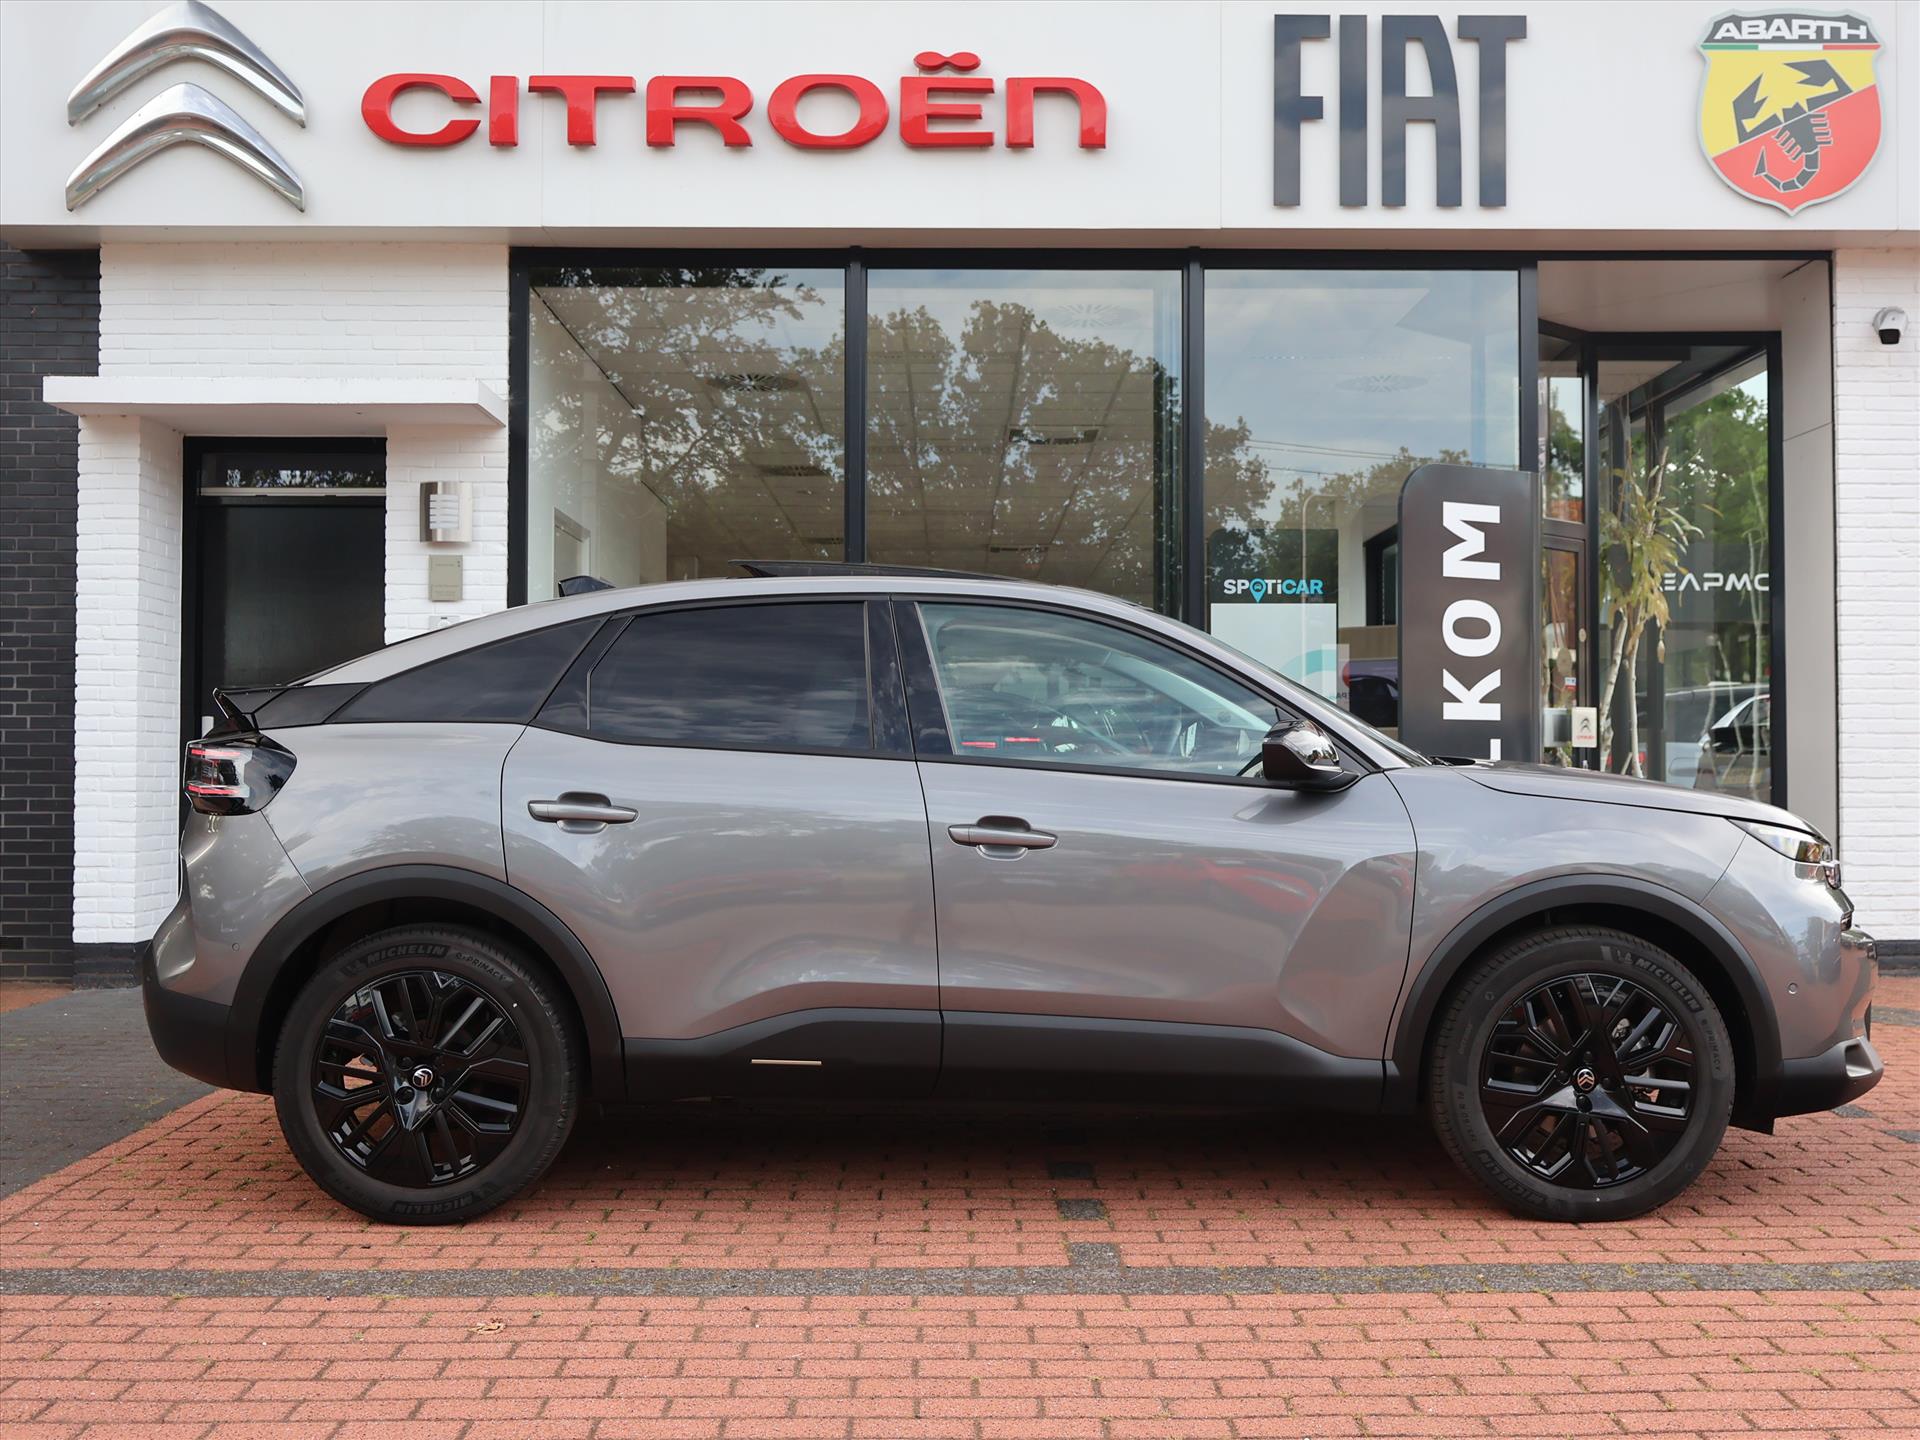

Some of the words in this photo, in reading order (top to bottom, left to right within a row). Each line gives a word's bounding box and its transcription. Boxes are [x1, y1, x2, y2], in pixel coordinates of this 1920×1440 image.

[1713, 18, 1867, 40] ABARTH
[361, 51, 1107, 149] CITROËN
[1274, 14, 1527, 207] FIAT
[367, 945, 447, 965] MICHELIN
[1636, 958, 1701, 1011] MICHELIN
[394, 1196, 474, 1214] MICHELIN
